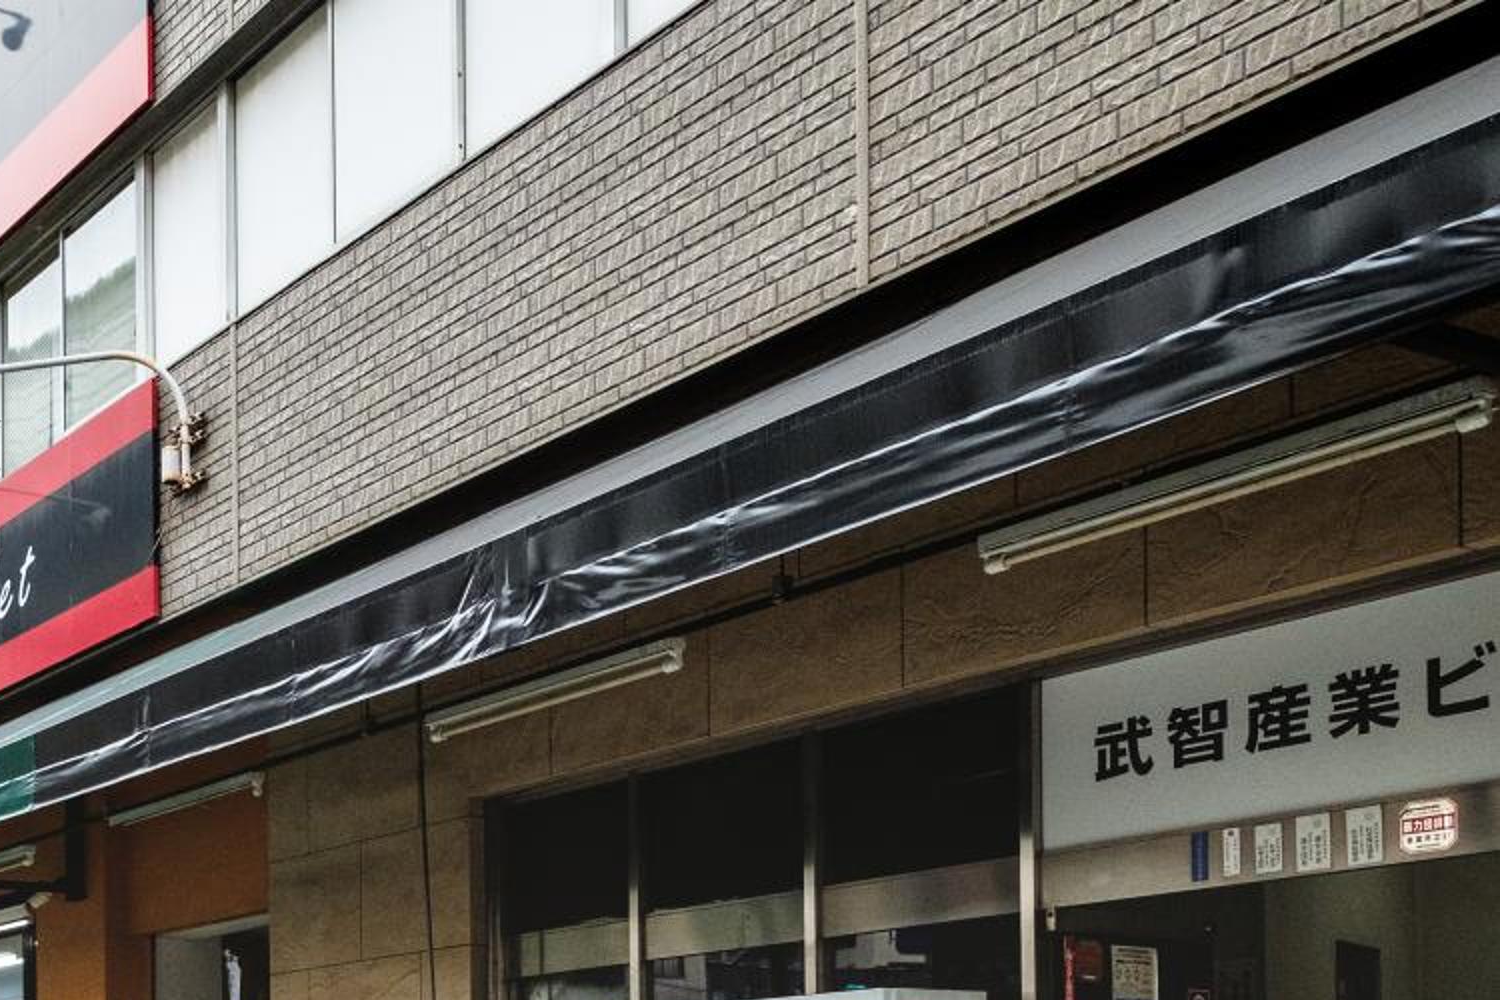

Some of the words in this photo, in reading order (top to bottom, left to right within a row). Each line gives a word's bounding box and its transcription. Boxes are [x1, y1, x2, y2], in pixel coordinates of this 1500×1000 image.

[1094, 640, 1497, 782] 武智産業ビ
